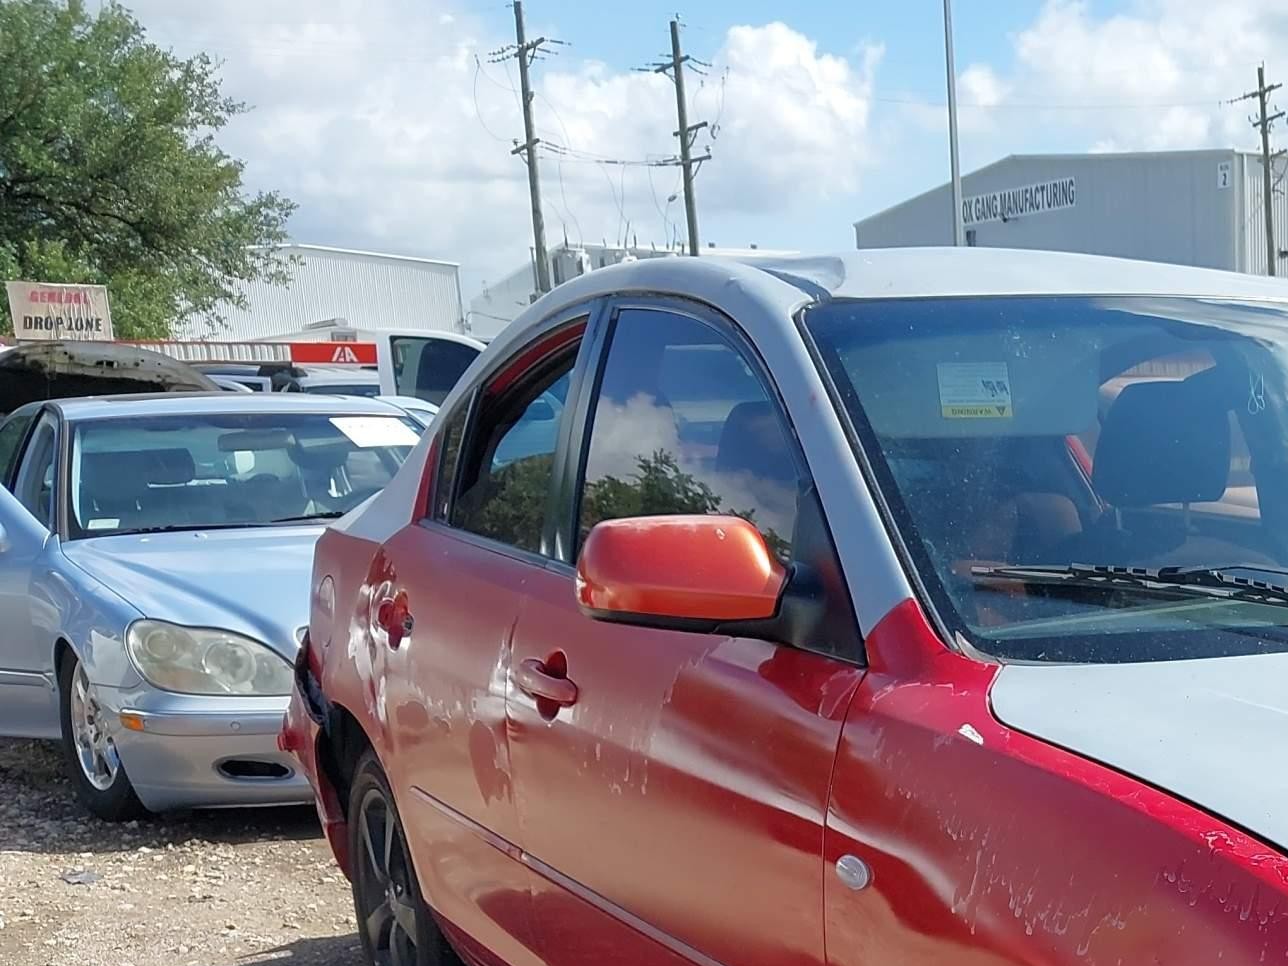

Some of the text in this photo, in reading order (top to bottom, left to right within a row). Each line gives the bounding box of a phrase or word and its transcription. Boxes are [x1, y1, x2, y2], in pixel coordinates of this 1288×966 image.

[962, 179, 1075, 224] OX GANG MANUFACTURING
[23, 315, 102, 332] DROP ZONE
